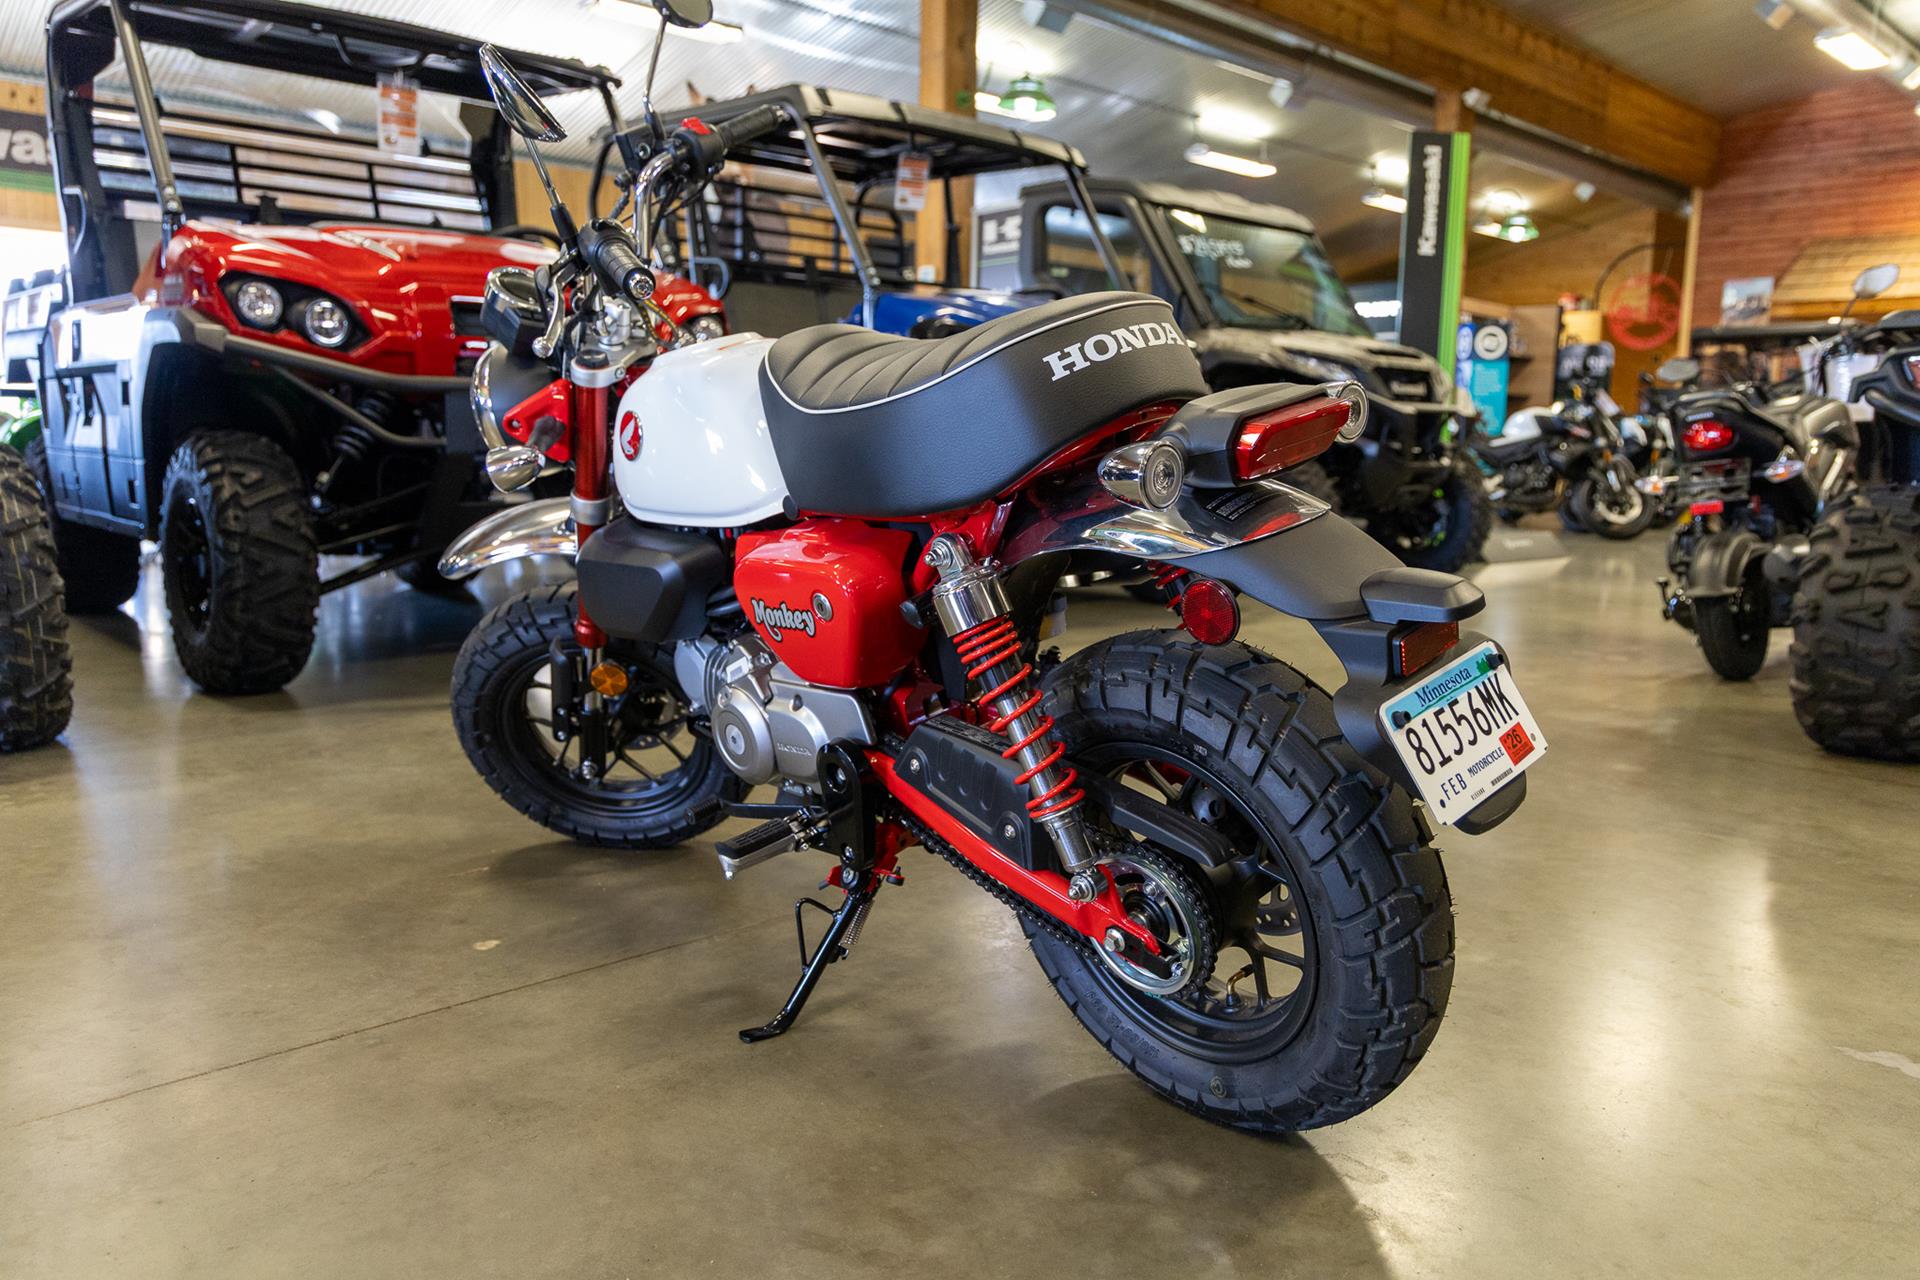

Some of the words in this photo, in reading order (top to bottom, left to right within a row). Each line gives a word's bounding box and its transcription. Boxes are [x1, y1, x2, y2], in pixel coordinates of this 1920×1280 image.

[1417, 144, 1442, 256] Kawasaki
[1042, 322, 1186, 382] HONDA
[751, 596, 816, 643] Monkey
[1414, 667, 1472, 707] Minnesota
[1405, 673, 1519, 775] 81556MK
[1440, 773, 1468, 800] FEB
[1467, 746, 1505, 778] MOTORCYCLE
